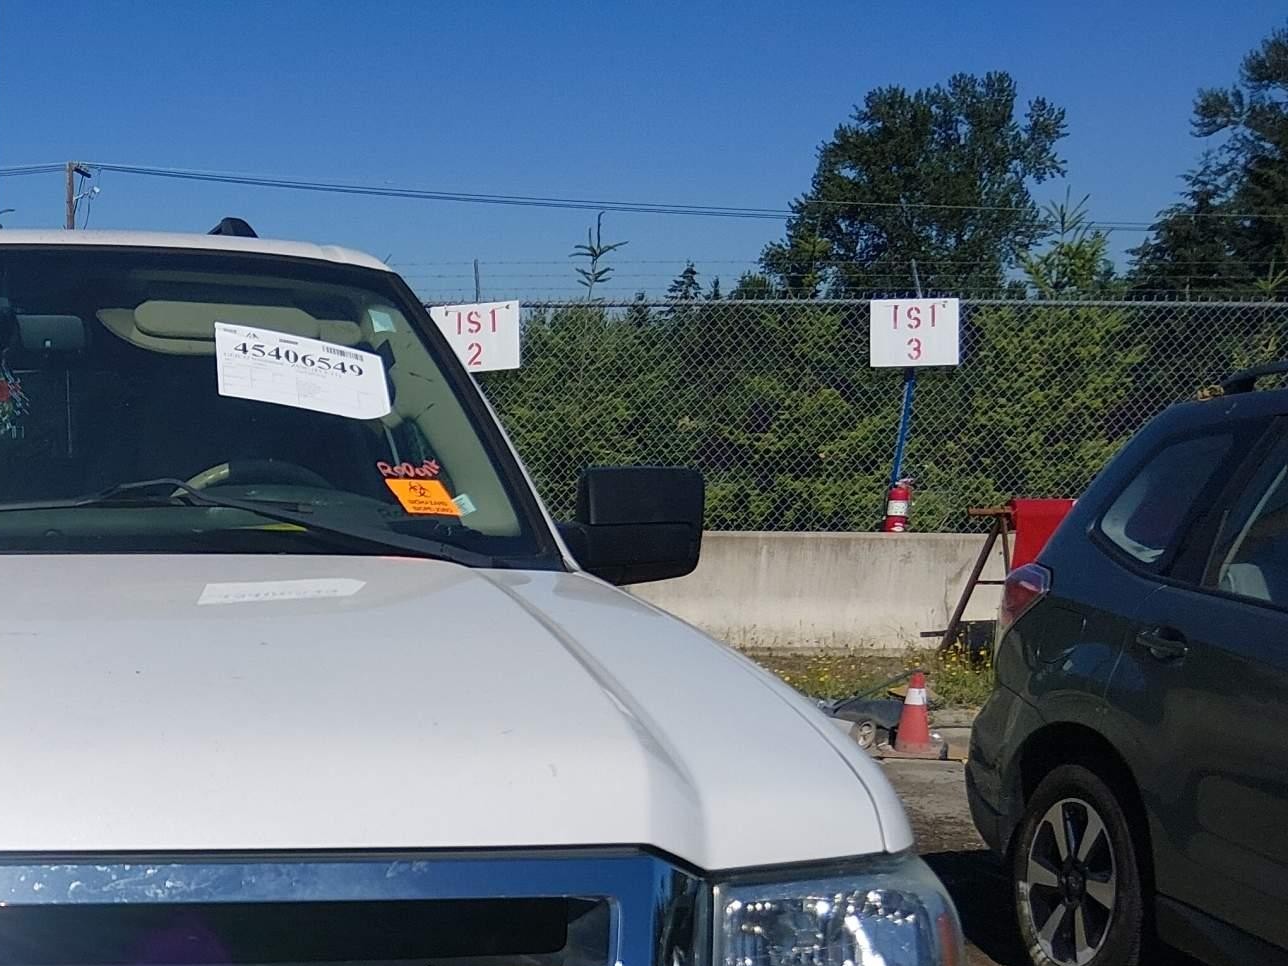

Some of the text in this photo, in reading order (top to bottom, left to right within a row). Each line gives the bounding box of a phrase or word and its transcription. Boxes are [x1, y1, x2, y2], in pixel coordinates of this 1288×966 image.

[233, 341, 364, 377] 45406549
[467, 342, 482, 366] 2
[907, 337, 922, 360] 3
